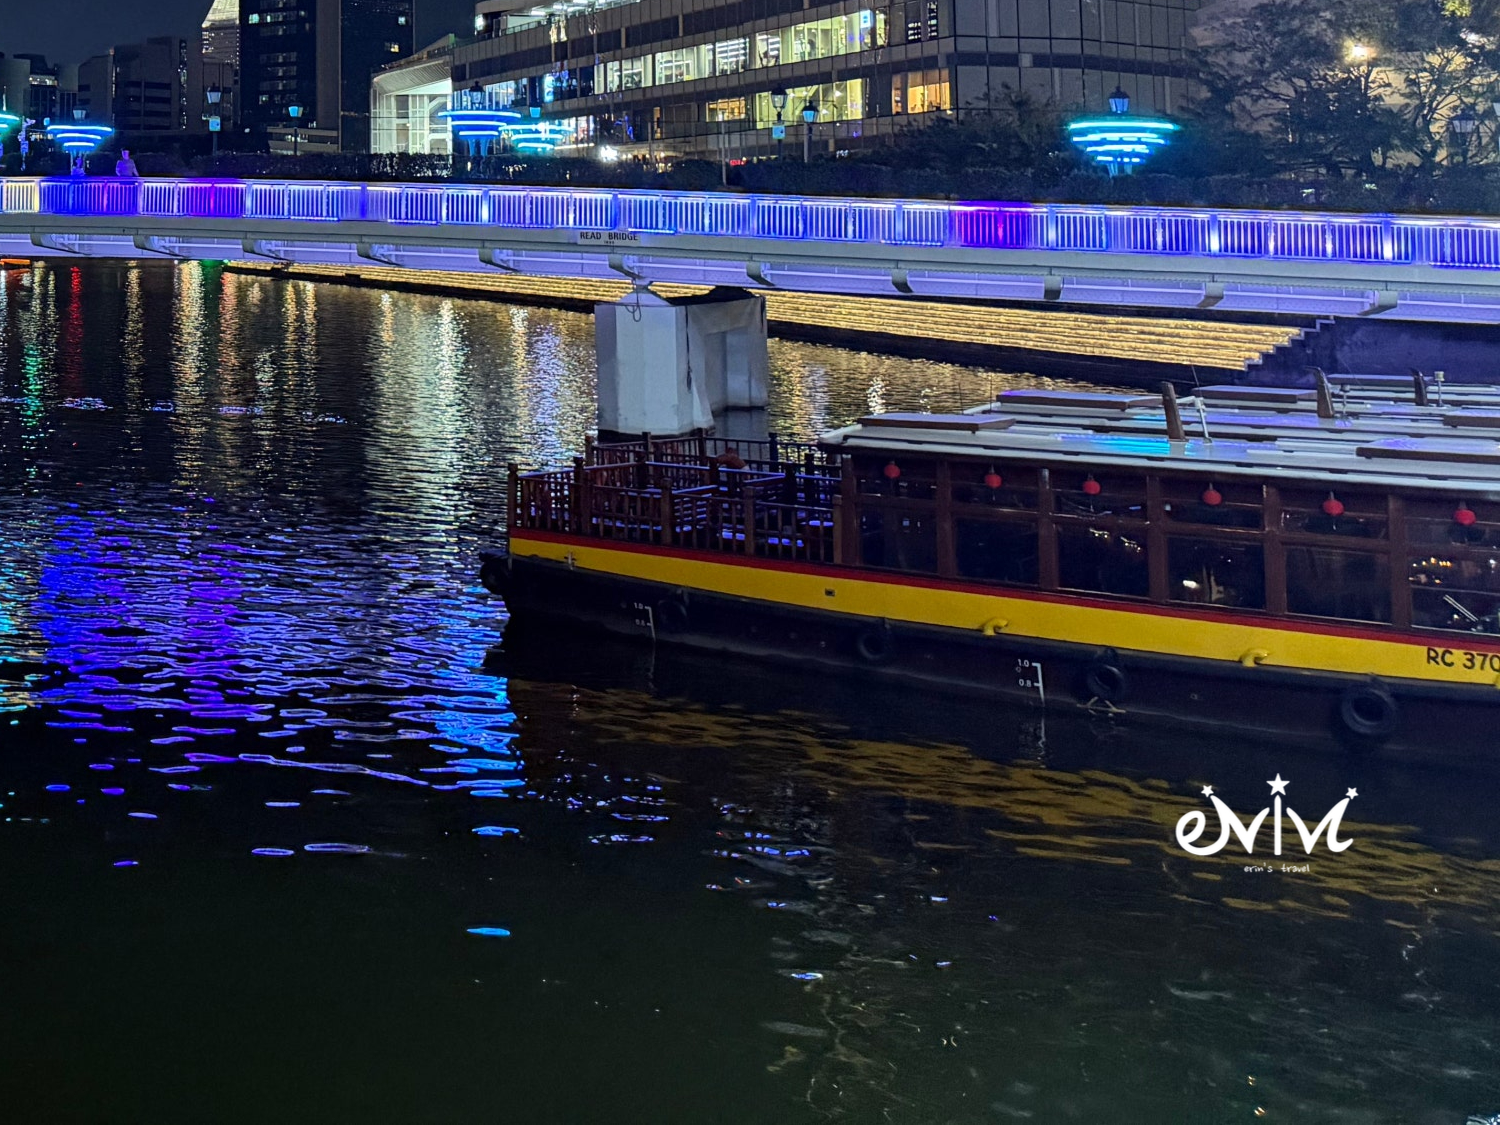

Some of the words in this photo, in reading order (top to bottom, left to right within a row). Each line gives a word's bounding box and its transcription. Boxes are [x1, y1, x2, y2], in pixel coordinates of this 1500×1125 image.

[580, 231, 602, 240] READ
[608, 232, 638, 241] BRIDGE
[1426, 646, 1455, 668] RC
